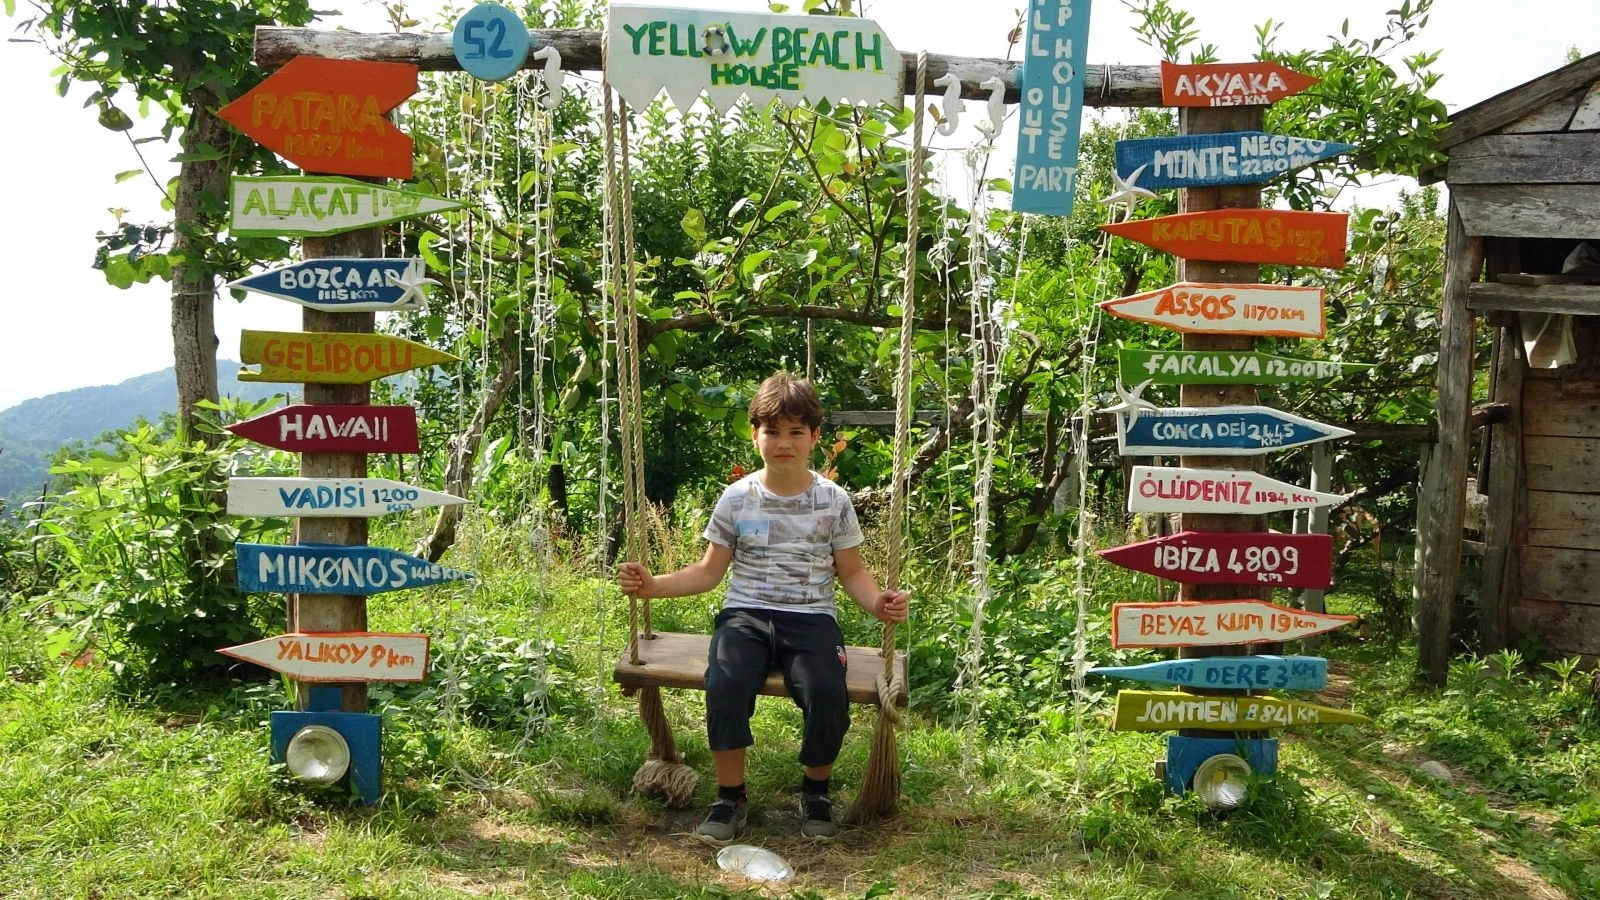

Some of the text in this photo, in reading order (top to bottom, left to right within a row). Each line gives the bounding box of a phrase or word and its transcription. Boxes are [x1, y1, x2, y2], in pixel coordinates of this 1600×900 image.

[464, 18, 513, 59] 52
[772, 26, 882, 71] BEACH
[710, 63, 800, 91] HOUSE
[1021, 0, 1050, 154] LL OUT
[1174, 72, 1288, 97] AKYAKA
[1048, 38, 1073, 160] HOUSE
[253, 93, 385, 136] PATARA
[1153, 135, 1327, 179] MONTE NEGRO
[1240, 158, 1289, 176] 2280
[1020, 165, 1076, 192] PART
[242, 186, 379, 221] ALAÇATI
[1153, 291, 1236, 320] ASSOS
[1243, 304, 1279, 321] 1170
[1143, 354, 1261, 377] FARALYA
[279, 414, 388, 443] HAWAII
[1153, 423, 1213, 440] CONCA
[371, 488, 419, 505] 1200
[1226, 546, 1299, 575] 4809
[1139, 613, 1210, 637] BEYAZ
[1216, 612, 1264, 632] KUM
[1269, 613, 1290, 632] 19
[1205, 664, 1270, 687] DERE
[1273, 665, 1289, 687] 3
